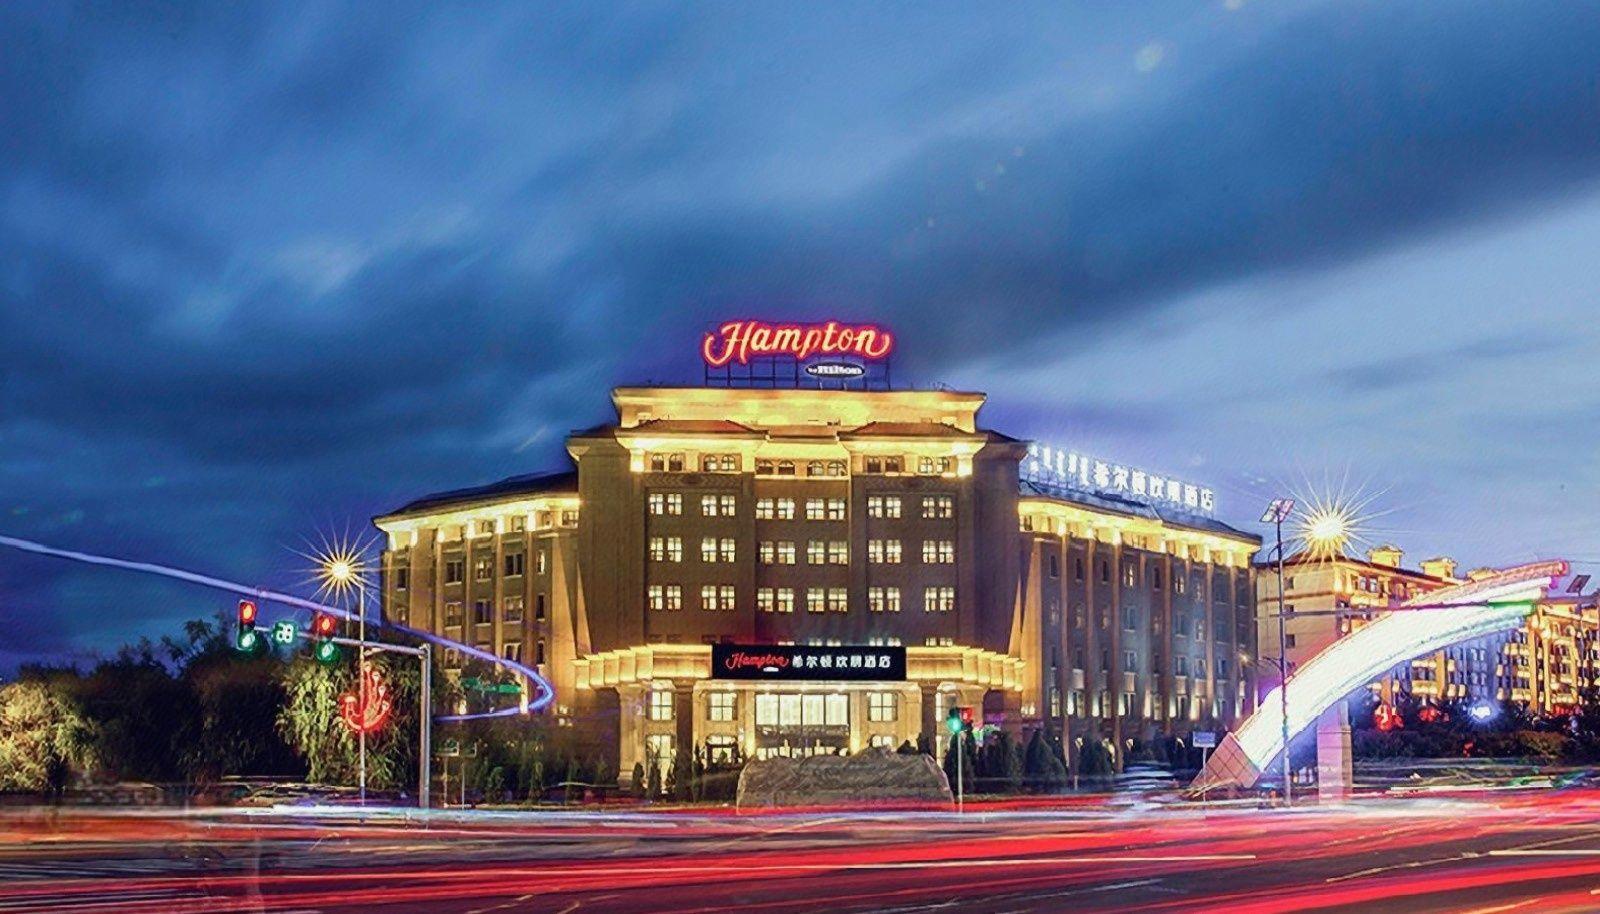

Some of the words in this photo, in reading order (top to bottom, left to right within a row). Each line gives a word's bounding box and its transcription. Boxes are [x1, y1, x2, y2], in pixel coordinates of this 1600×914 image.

[704, 321, 891, 366] Hampton
[725, 652, 789, 669] Hampton
[792, 654, 891, 668] 希尔顿欢朋酒店
